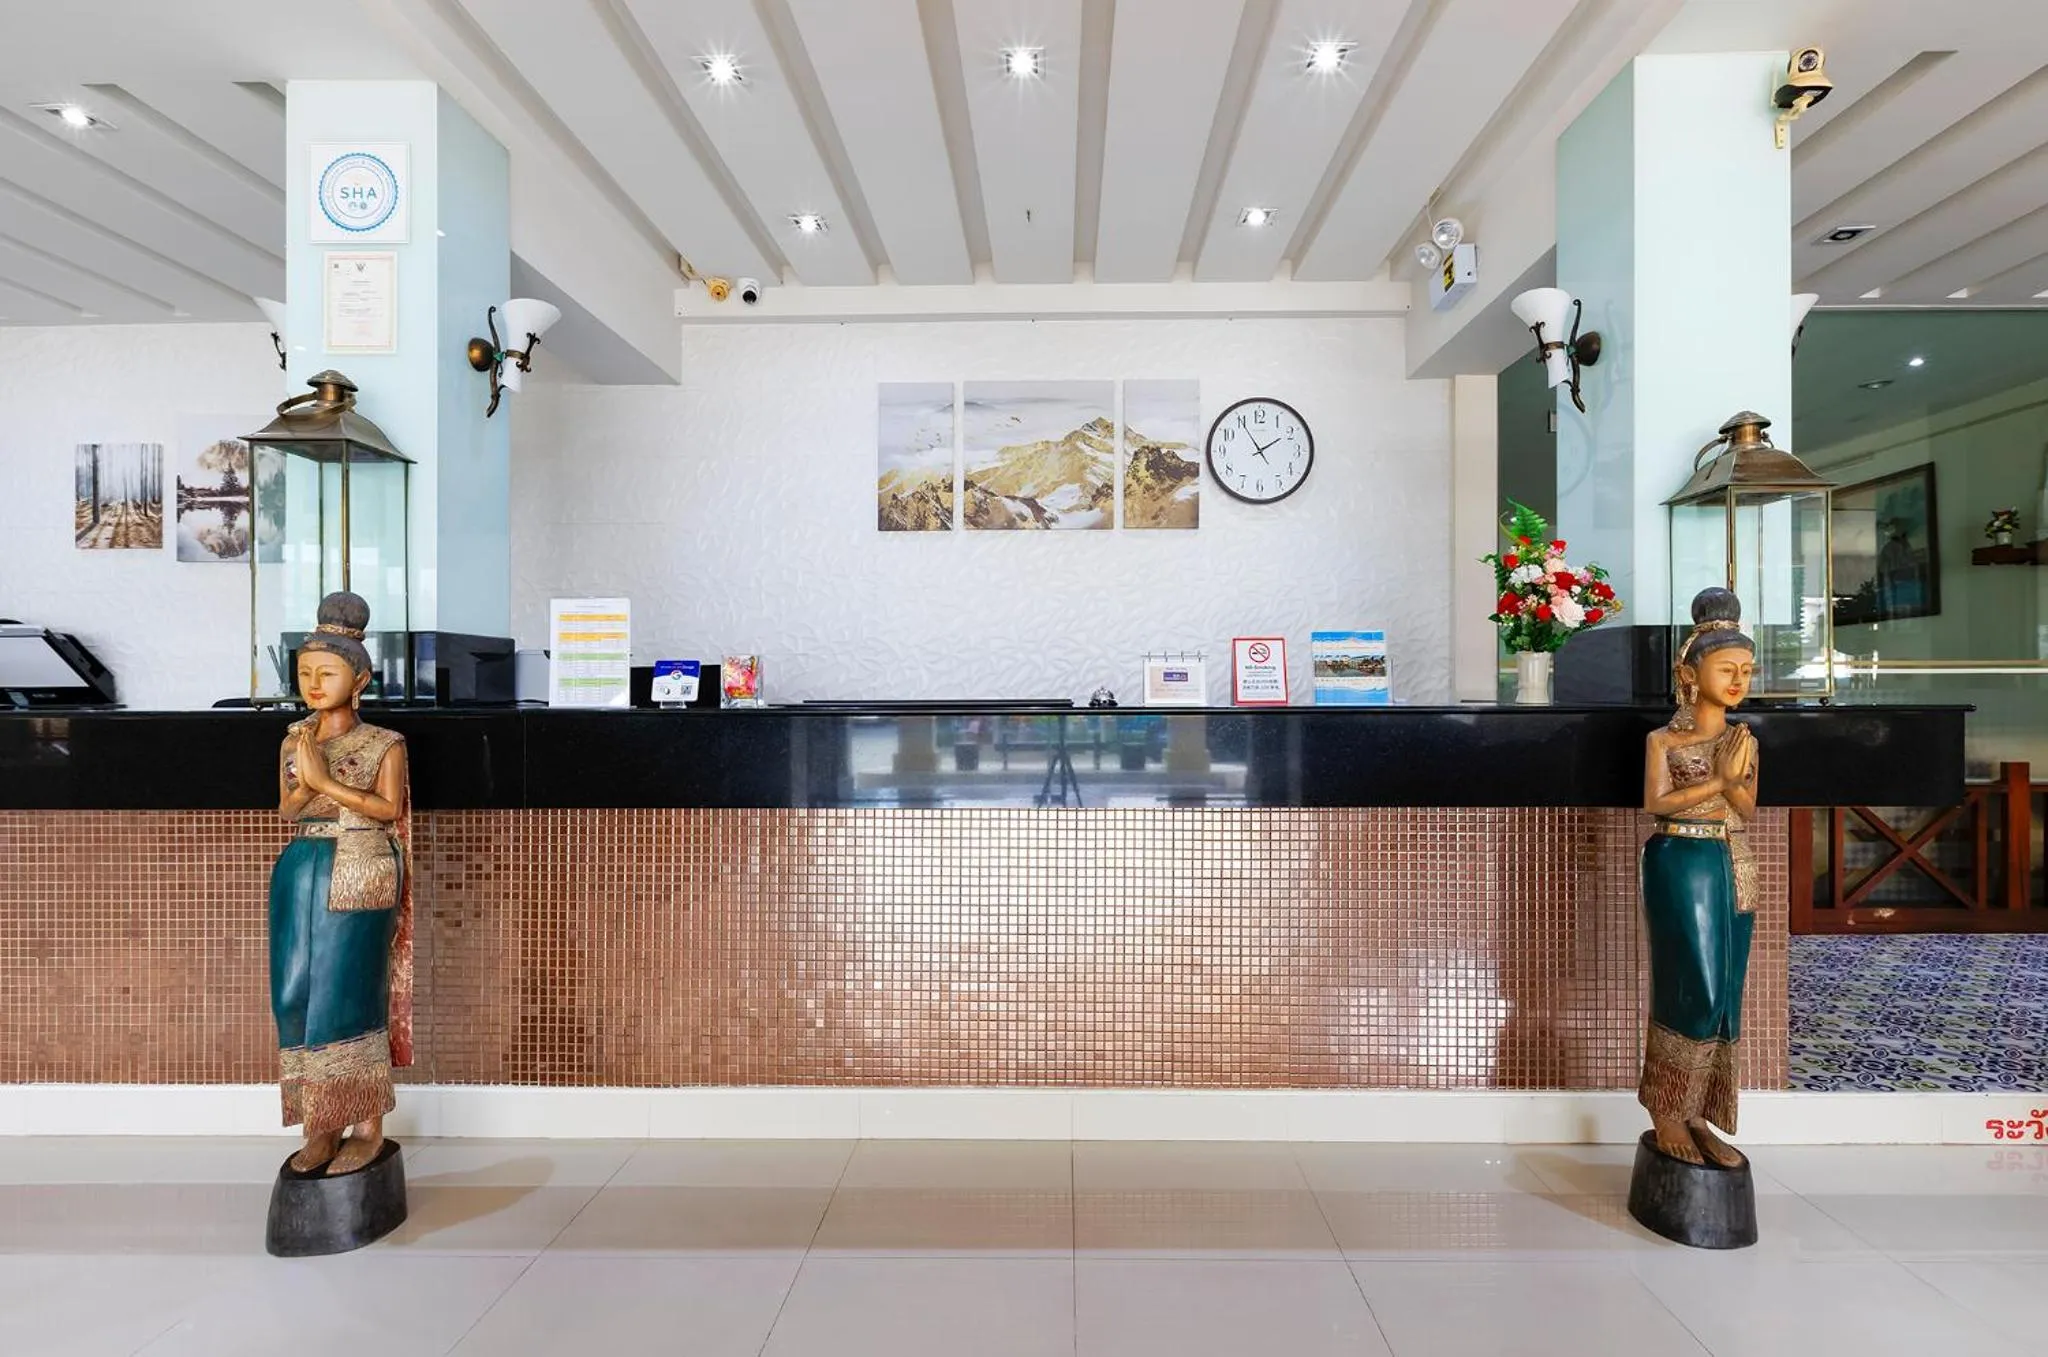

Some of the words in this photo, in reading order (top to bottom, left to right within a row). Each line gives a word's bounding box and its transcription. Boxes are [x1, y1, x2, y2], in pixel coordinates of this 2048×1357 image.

[340, 186, 377, 199] SHA
[1254, 409, 1266, 425] 12
[1275, 414, 1280, 429] 1
[1223, 428, 1235, 442] 10
[1286, 426, 1294, 441] 2
[1218, 444, 1227, 458] 9
[1293, 444, 1301, 458] 3
[1225, 463, 1234, 477] 8
[1287, 461, 1294, 476] 4
[1239, 474, 1246, 489] 7
[1255, 478, 1264, 493] 6
[1275, 474, 1283, 490] 5
[1986, 1109, 2048, 1140] ระวั
